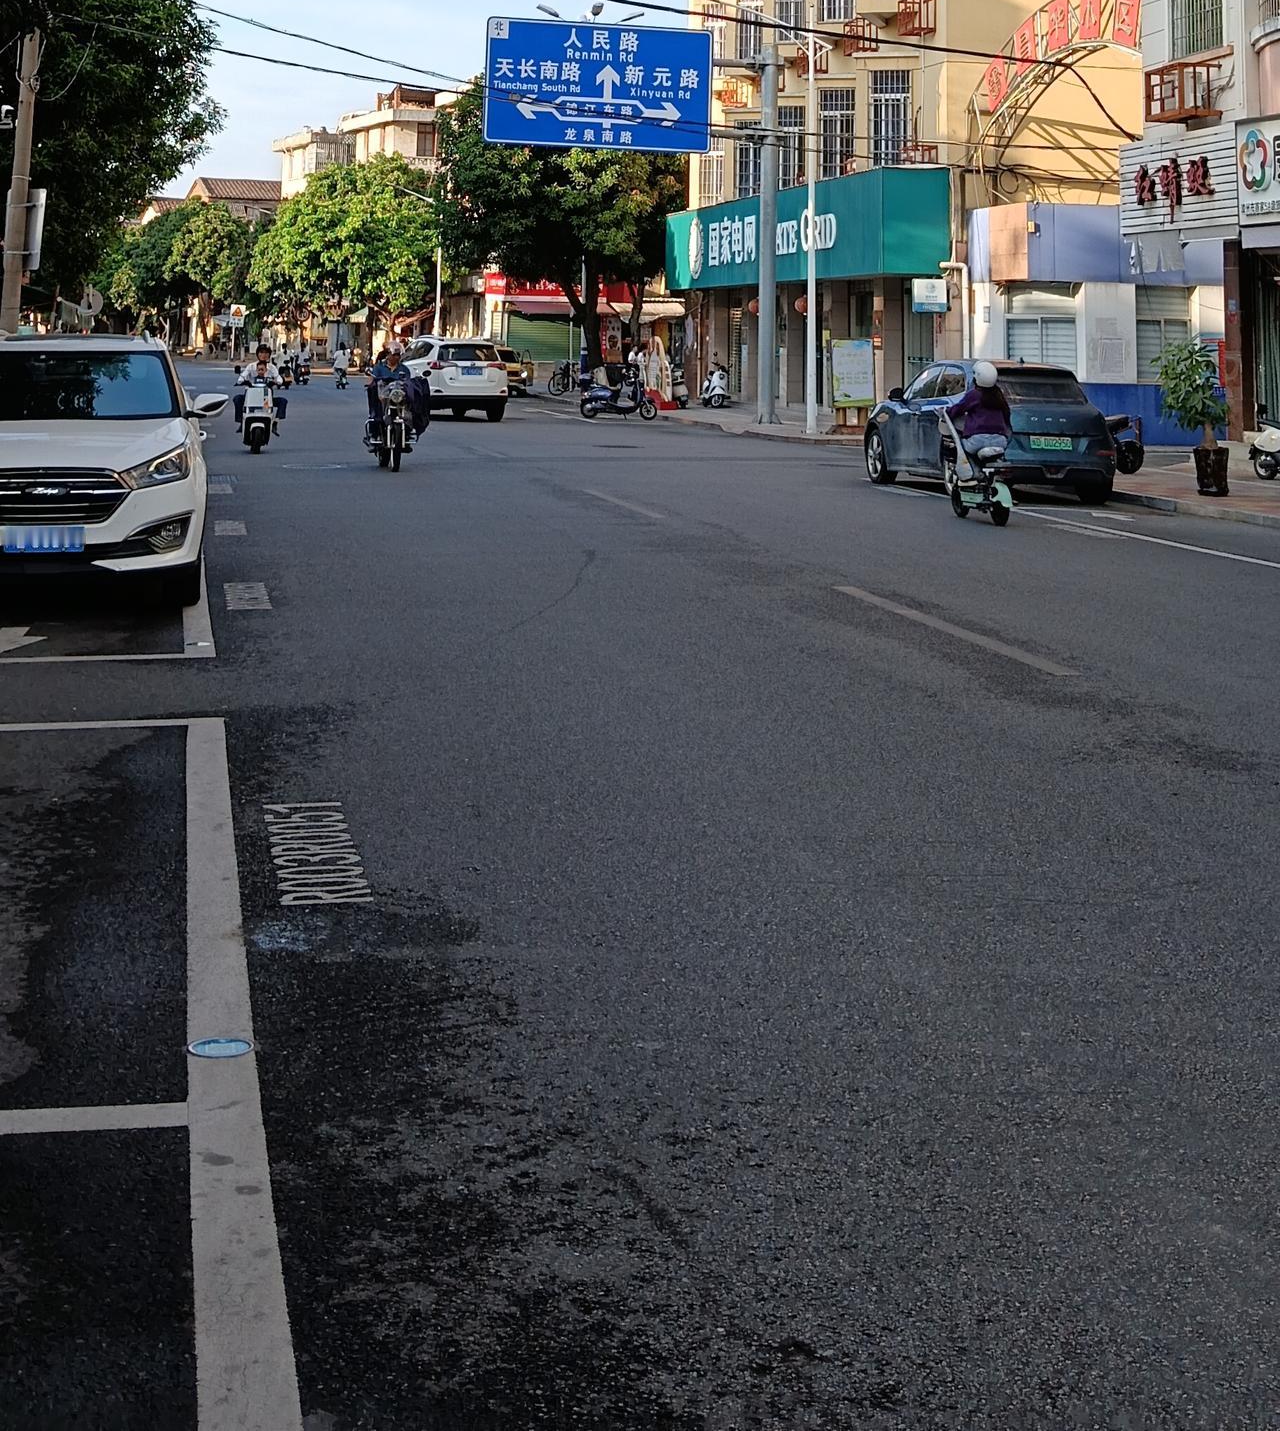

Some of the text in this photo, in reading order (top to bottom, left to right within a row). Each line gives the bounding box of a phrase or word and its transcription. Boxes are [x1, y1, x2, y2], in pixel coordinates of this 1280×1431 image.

[494, 19, 504, 32] 北
[564, 28, 640, 52] 人民路
[566, 49, 634, 63] Renmin Rd
[494, 57, 582, 83] 天长南路
[624, 64, 700, 89] 新元路
[493, 79, 581, 94] Tianchang South Rd
[630, 87, 691, 101] Xinyuan Rd
[564, 127, 633, 145] 龙泉南路
[708, 214, 757, 267] 国家电网
[800, 208, 837, 251] GRID
[261, 801, 374, 906] R003R0051
